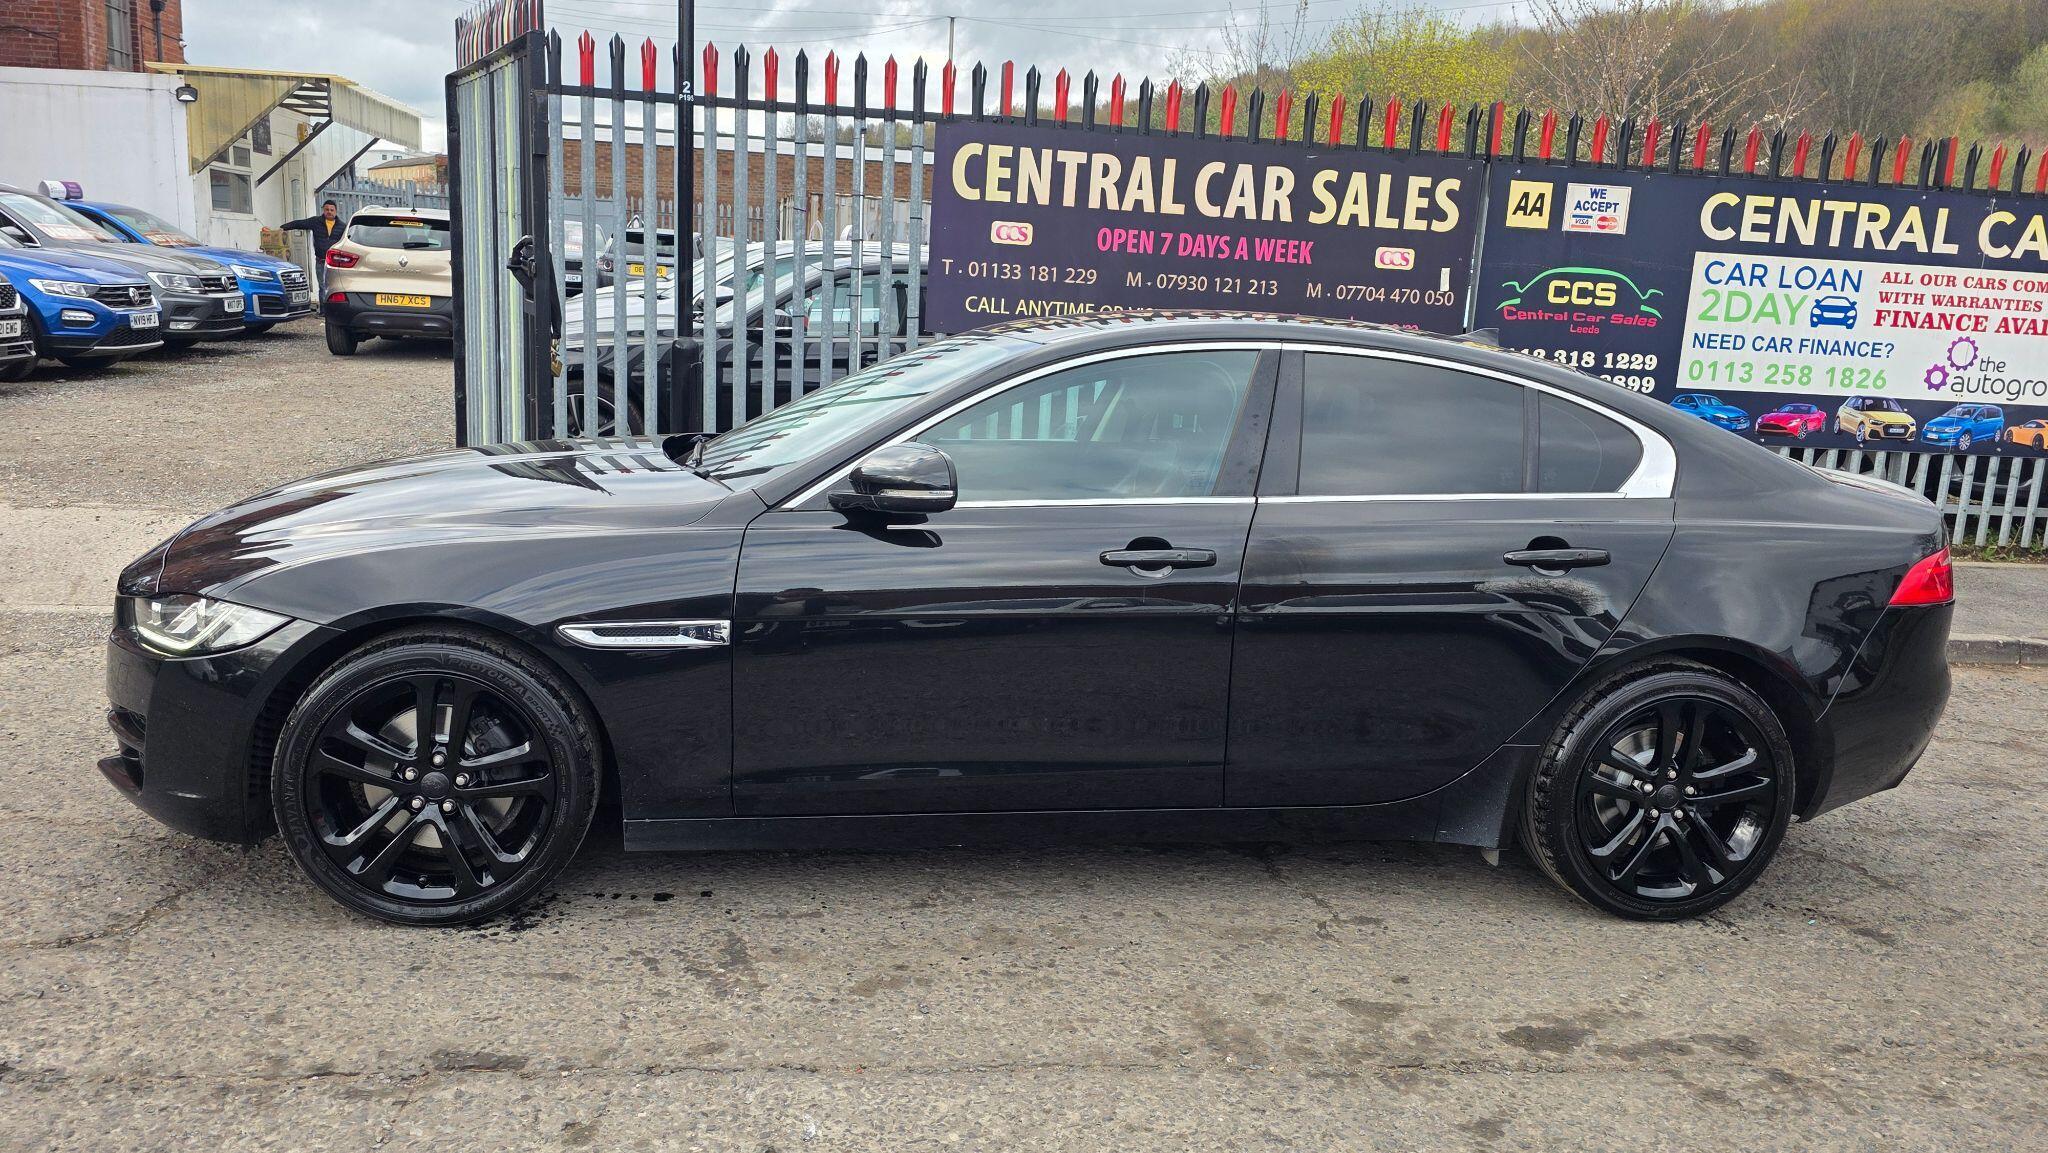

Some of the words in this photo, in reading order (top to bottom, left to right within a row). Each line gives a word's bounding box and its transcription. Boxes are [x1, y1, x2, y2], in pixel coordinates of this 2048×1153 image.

[683, 81, 690, 93] 2
[952, 142, 1186, 215] CENTRAL
[1194, 162, 1295, 222] CAR
[1308, 170, 1461, 233] SALES
[1590, 188, 1607, 199] WE
[1512, 192, 1546, 216] AA
[1574, 200, 1619, 213] ACCEPT
[1700, 192, 1959, 254] CENTRAL
[1978, 211, 2048, 260] CA
[1097, 228, 1154, 254] OPEN
[1160, 233, 1174, 255] 7
[1178, 233, 1230, 260] DAYS
[1234, 237, 1249, 260] A
[1255, 238, 1314, 265] WEEK
[968, 261, 1022, 280] 01133
[1030, 266, 1057, 282] 181
[1064, 268, 1097, 284] 229
[1704, 260, 1768, 287] CAR
[1778, 265, 1863, 293] LOAN
[1881, 272, 1914, 285] ALL
[1920, 273, 1957, 288] OUR
[1964, 276, 2007, 290] CARS
[2013, 280, 2048, 293] COM
[1156, 274, 1207, 292] 07930
[1214, 277, 1240, 293] 121
[1248, 279, 1278, 296] 213
[1336, 285, 1385, 301] 07704
[1390, 289, 1420, 304] 470
[1425, 290, 1454, 306] 050
[1548, 280, 1616, 306] CCS
[380, 294, 404, 304] HN67
[408, 296, 426, 305] XCS
[965, 296, 1010, 314] CALL
[1016, 300, 1094, 316] ANYTIME
[1698, 289, 1809, 326] 2DAY
[1879, 291, 1925, 306] WITH
[1931, 294, 2042, 312] WARRANTIES
[1503, 306, 1568, 321] Central
[1573, 312, 1605, 323] Car
[1610, 314, 1658, 328] Sales
[1873, 309, 1989, 332] FINANCE
[1570, 324, 1600, 334] Leeds
[1692, 333, 1745, 352] NEED
[1752, 336, 1793, 354] CAR
[1798, 338, 1894, 358] FINANCE?
[1554, 350, 1595, 367] 318
[1604, 353, 1658, 370] 1229
[1979, 356, 2006, 373] the
[1688, 359, 1754, 384] 0113
[1764, 364, 1813, 386] 258
[1826, 366, 1887, 390] 1826
[1951, 374, 2048, 401] autogro
